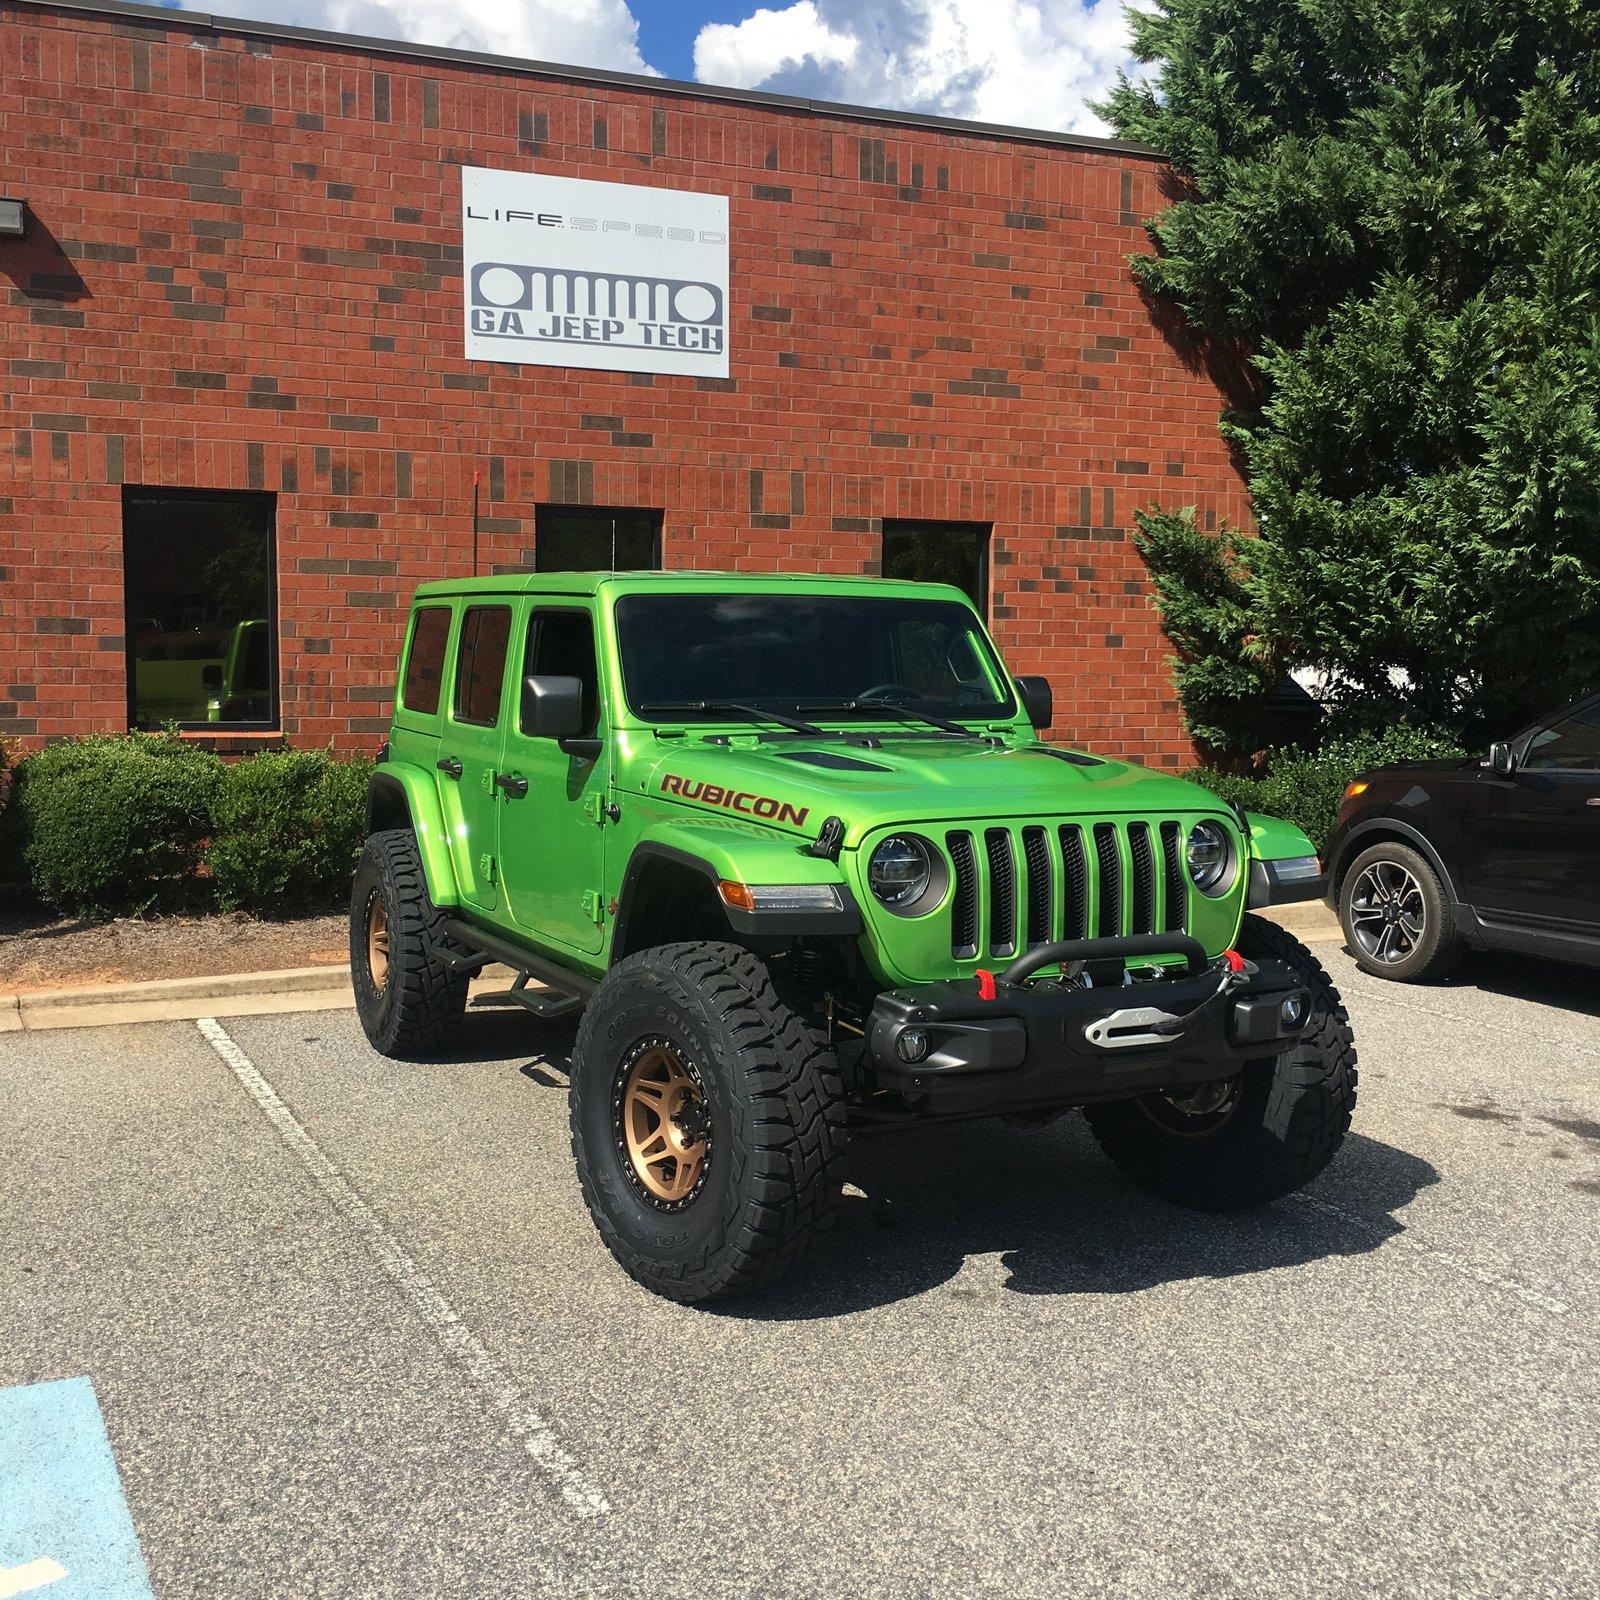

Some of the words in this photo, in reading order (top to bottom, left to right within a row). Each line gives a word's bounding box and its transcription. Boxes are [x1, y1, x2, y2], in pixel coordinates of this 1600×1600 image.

[471, 309, 524, 335] GA
[538, 316, 625, 342] JEEP
[638, 322, 723, 350] TECH
[660, 773, 811, 827] RUBICON
